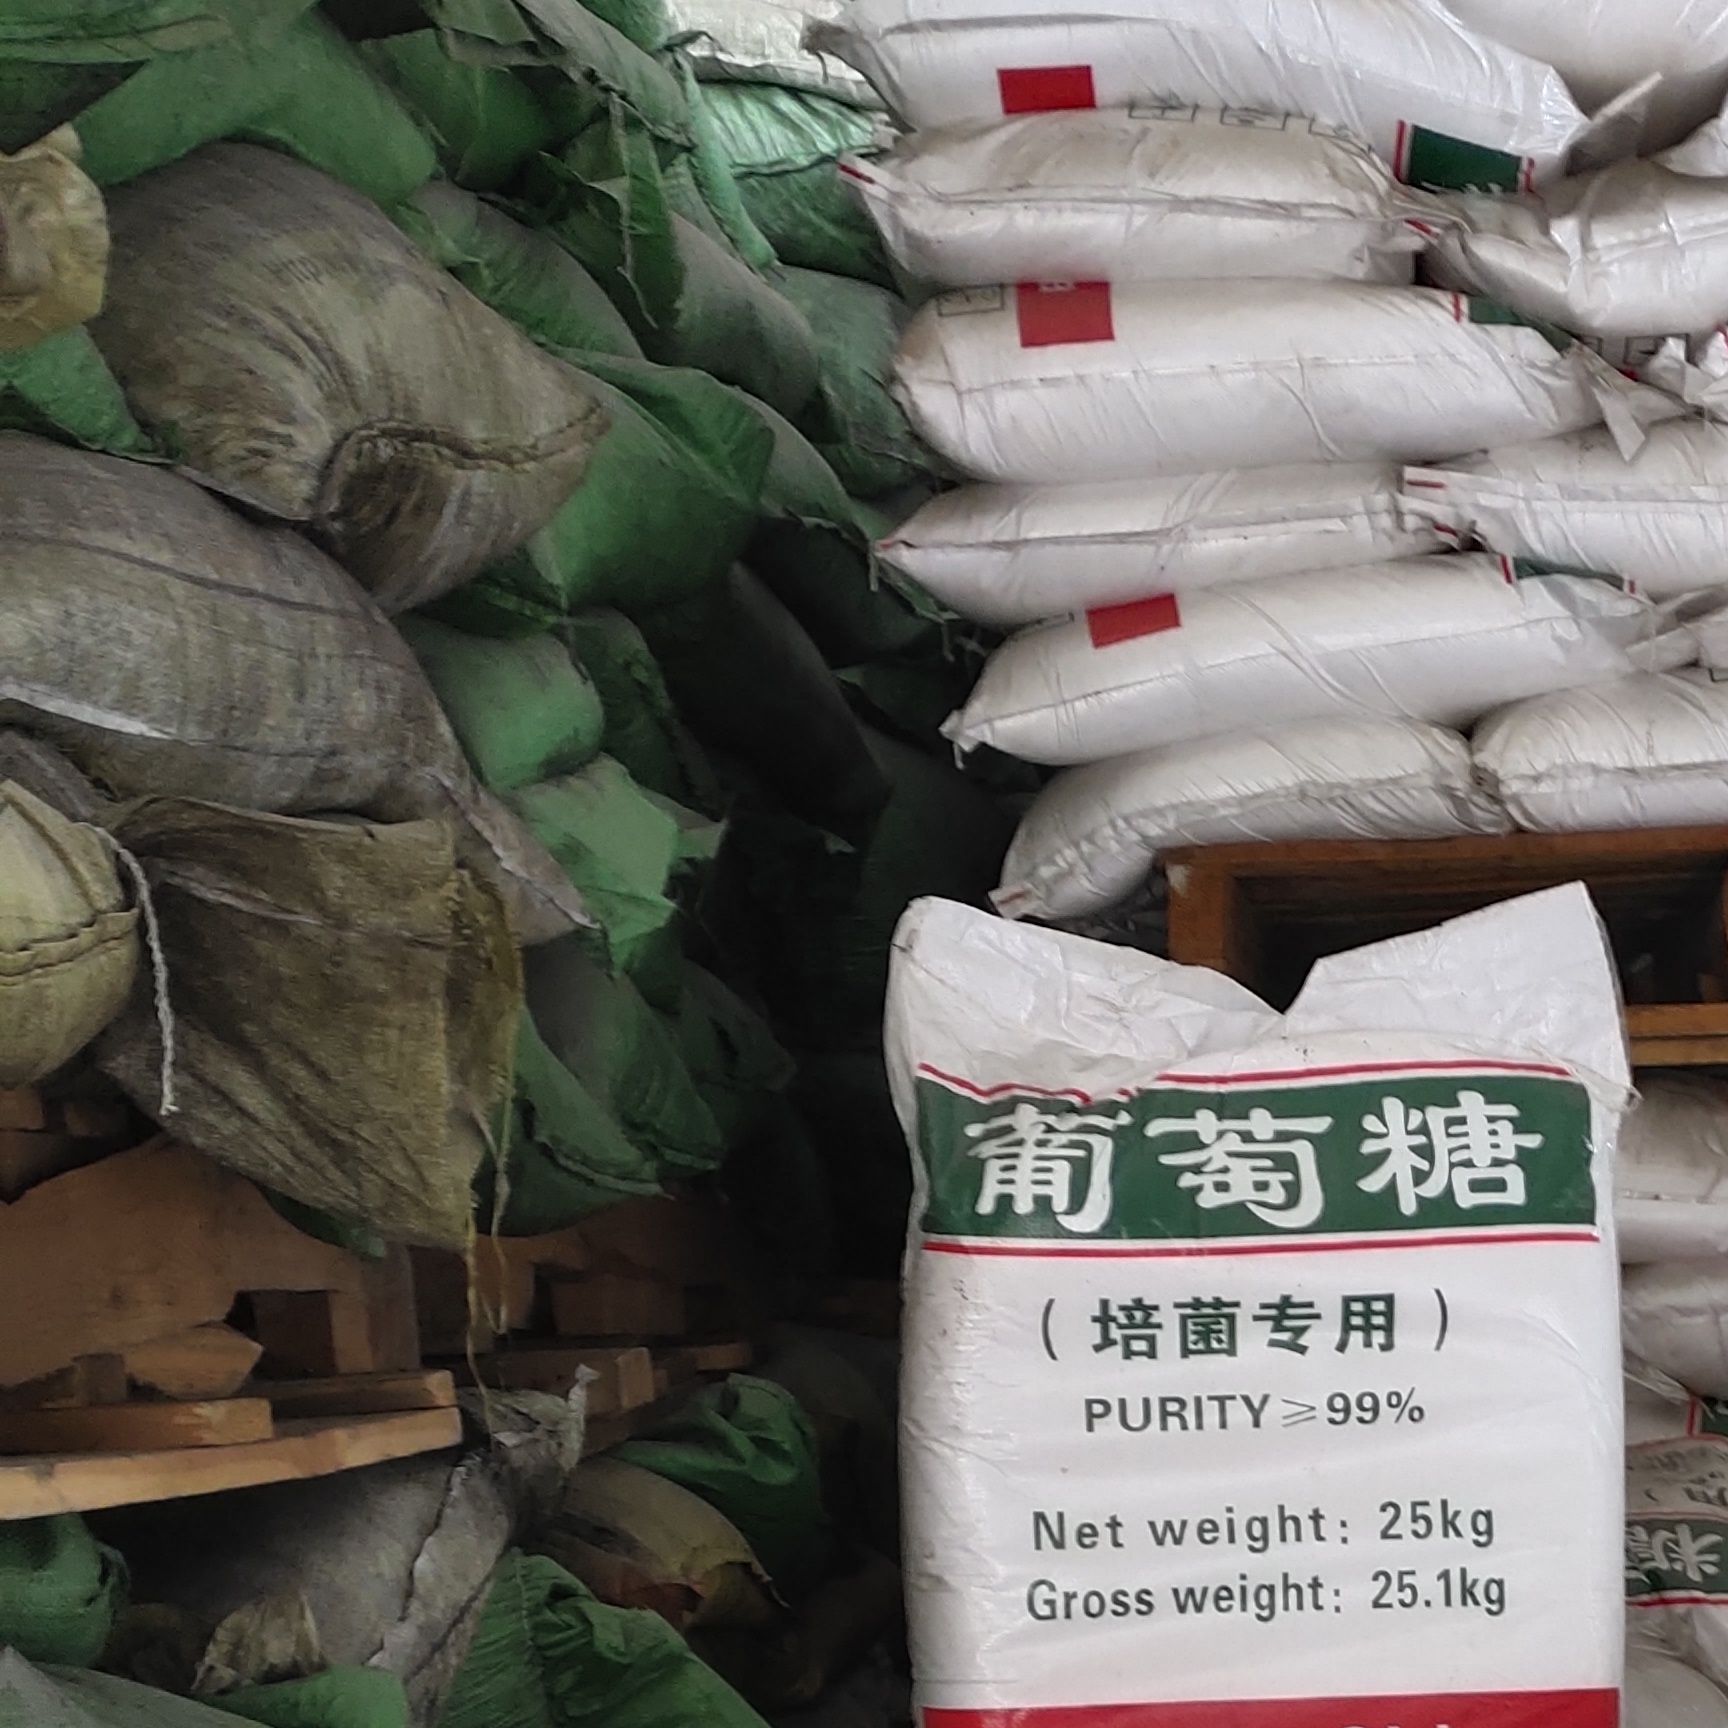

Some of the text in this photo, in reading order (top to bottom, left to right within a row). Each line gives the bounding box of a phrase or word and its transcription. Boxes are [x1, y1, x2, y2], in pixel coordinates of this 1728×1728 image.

[963, 1088, 1543, 1232] 葡萄糖
[1032, 1499, 1496, 1553] Net weight: 25kg
[1026, 1567, 1507, 1622] Gross weight: 25.1kg
